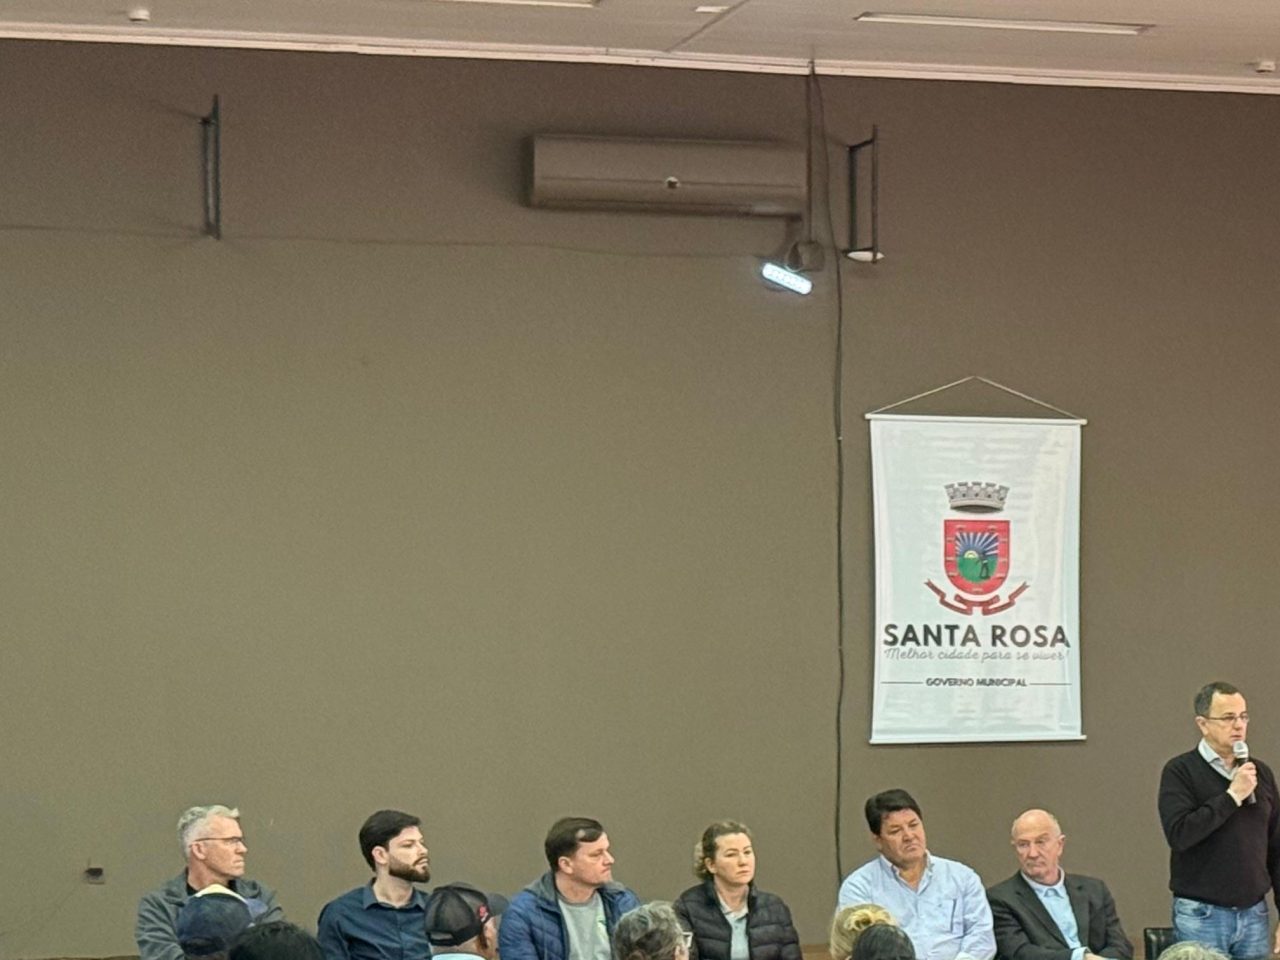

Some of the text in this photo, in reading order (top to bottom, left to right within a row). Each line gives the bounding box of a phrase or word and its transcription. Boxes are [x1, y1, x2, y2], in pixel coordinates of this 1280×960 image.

[883, 624, 1071, 648] SANTA ROSA
[884, 647, 935, 661] Melhor
[937, 648, 980, 660] cidade
[925, 677, 1028, 687] GOVERNO MUNICIPAL
